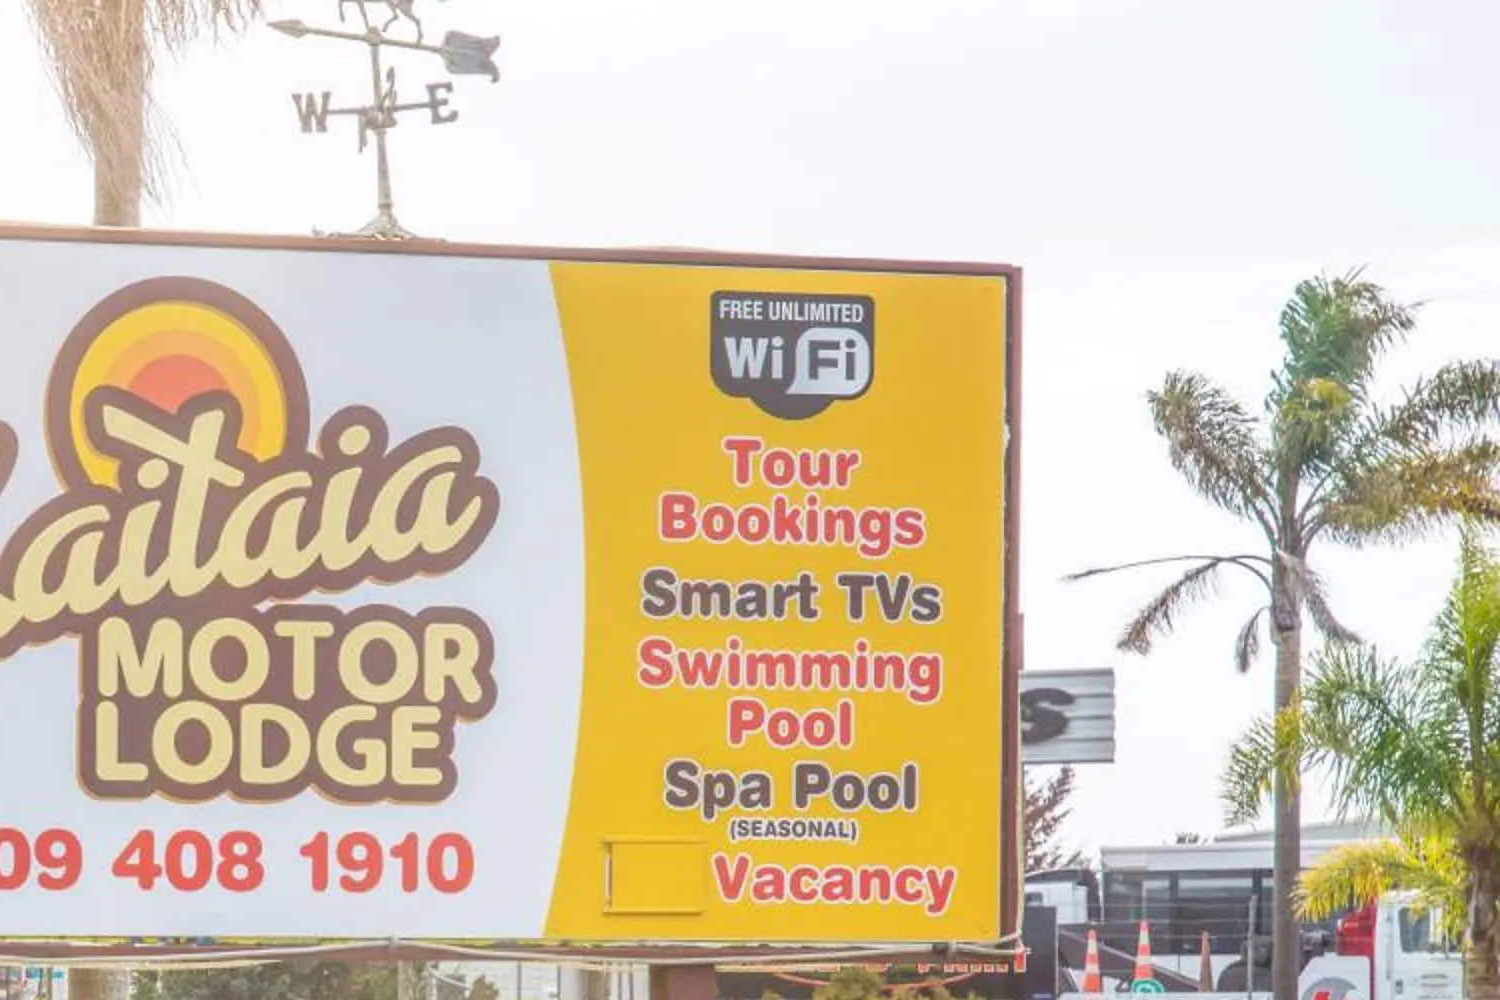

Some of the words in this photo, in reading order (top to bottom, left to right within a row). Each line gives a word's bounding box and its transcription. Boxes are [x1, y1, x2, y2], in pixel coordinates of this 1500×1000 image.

[719, 299, 763, 320] FREE
[769, 301, 864, 323] UNLIMITED
[725, 438, 858, 487] Tour
[660, 494, 924, 556] Bookings
[642, 569, 817, 619] Smart
[838, 575, 941, 621] TVs
[97, 616, 483, 704] MOTOR
[640, 639, 941, 701] Swimming
[96, 700, 443, 786] LODGE
[729, 700, 851, 745] Pool
[666, 762, 770, 818] Spa
[795, 764, 916, 809] Pool
[729, 819, 858, 842] (SEASONAL)
[112, 829, 264, 892] 408
[299, 831, 475, 893] 1910
[714, 856, 956, 913] Vacancy
